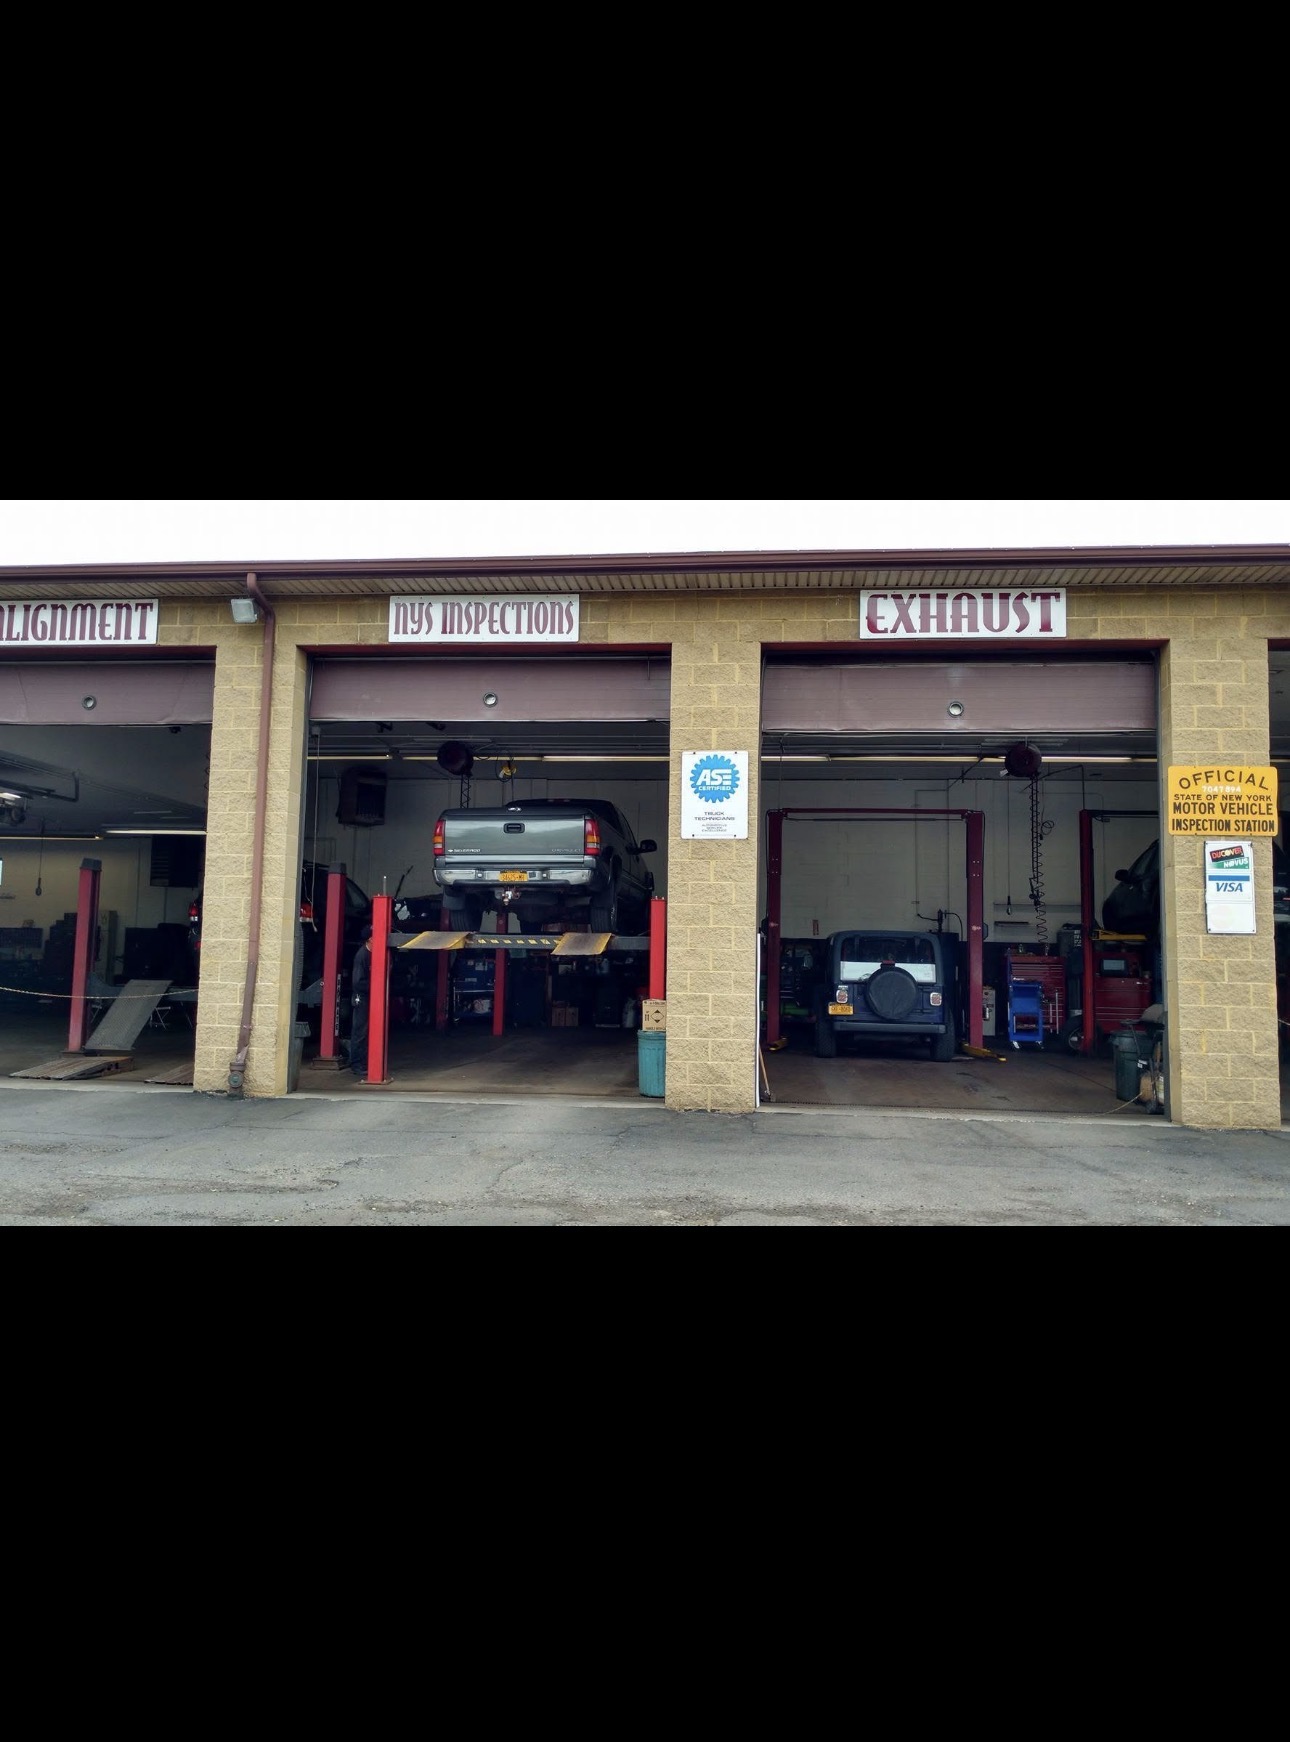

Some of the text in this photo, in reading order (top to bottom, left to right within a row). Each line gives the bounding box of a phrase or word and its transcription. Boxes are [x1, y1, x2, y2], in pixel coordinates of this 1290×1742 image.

[394, 601, 574, 635] NYS INSPECTIONS
[866, 591, 1060, 634] EXHAUST
[696, 769, 732, 786] ASE
[1179, 770, 1269, 790] OFFICIAL
[1173, 802, 1273, 815] MOTOR VEHICLE
[1172, 819, 1275, 832] INSPECTION STATION
[1223, 858, 1249, 868] NOVUS
[1215, 882, 1243, 892] VISA
